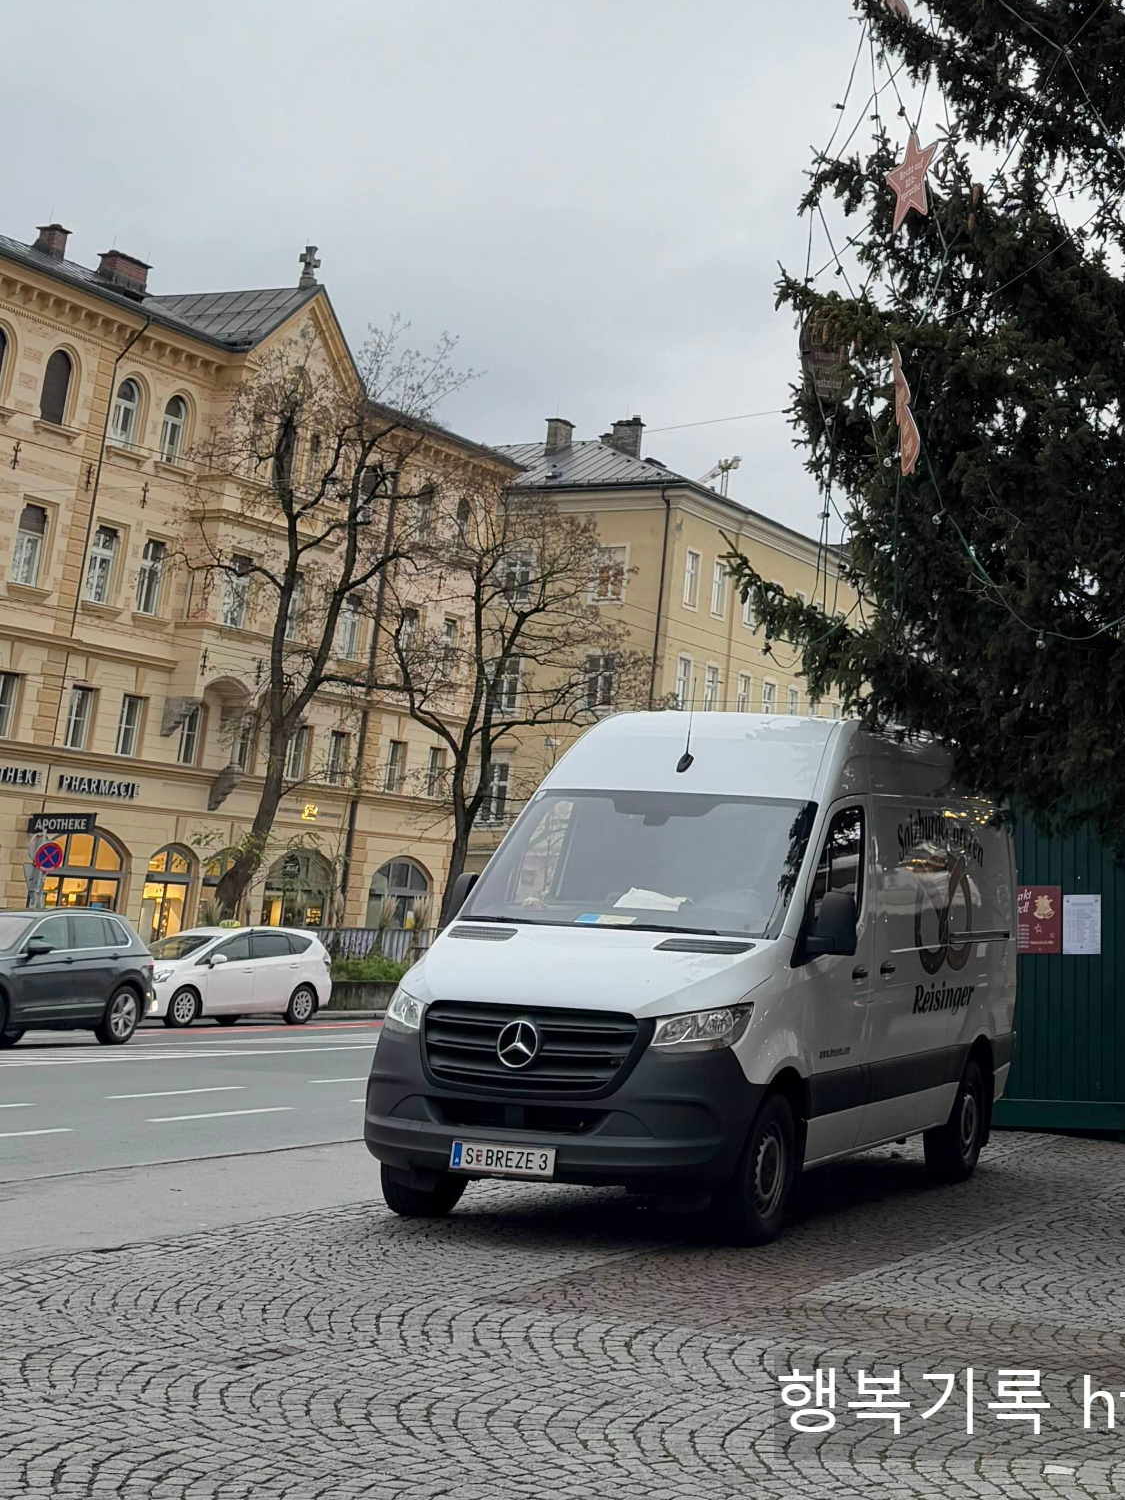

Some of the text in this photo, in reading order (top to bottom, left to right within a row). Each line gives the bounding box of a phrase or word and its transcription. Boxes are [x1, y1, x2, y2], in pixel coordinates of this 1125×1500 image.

[61, 774, 140, 798] PHARMACIE
[34, 818, 87, 831] APOTHEKE
[912, 980, 975, 1016] Reisinger
